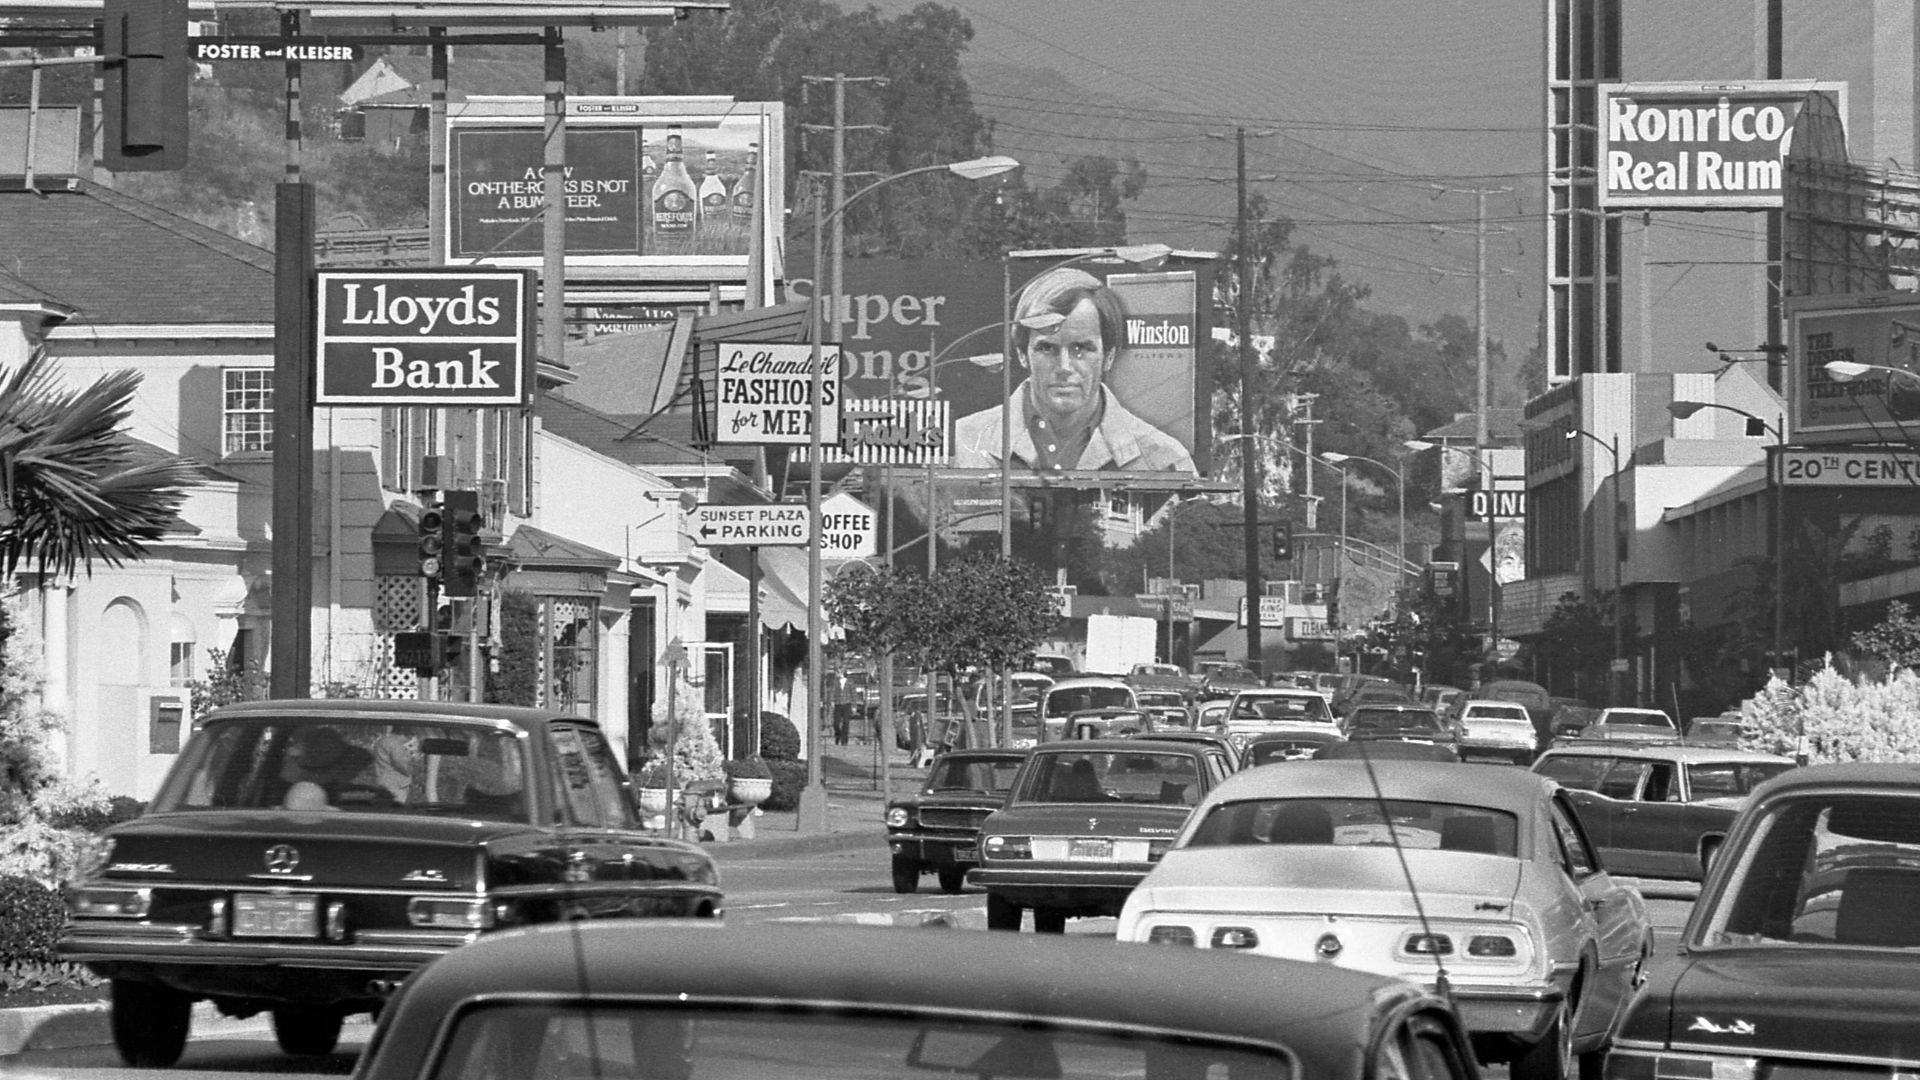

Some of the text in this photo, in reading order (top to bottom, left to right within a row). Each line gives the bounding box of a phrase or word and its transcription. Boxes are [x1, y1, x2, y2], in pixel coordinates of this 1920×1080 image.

[198, 44, 261, 59] FOSTER
[286, 45, 353, 60] KLEISER
[1609, 96, 1784, 142] Ronrico
[524, 167, 537, 180] A
[1608, 150, 1782, 191] Real Rum
[580, 180, 594, 193] IS
[597, 179, 629, 193] NOT
[498, 198, 511, 210] A
[342, 283, 500, 335] Lloyds
[1127, 319, 1190, 345] Winston
[371, 347, 500, 389] Bank
[732, 411, 758, 434] for
[701, 510, 805, 522] SUNSET PLAZA
[820, 514, 870, 530] OFFEE
[722, 525, 803, 538] PARKING
